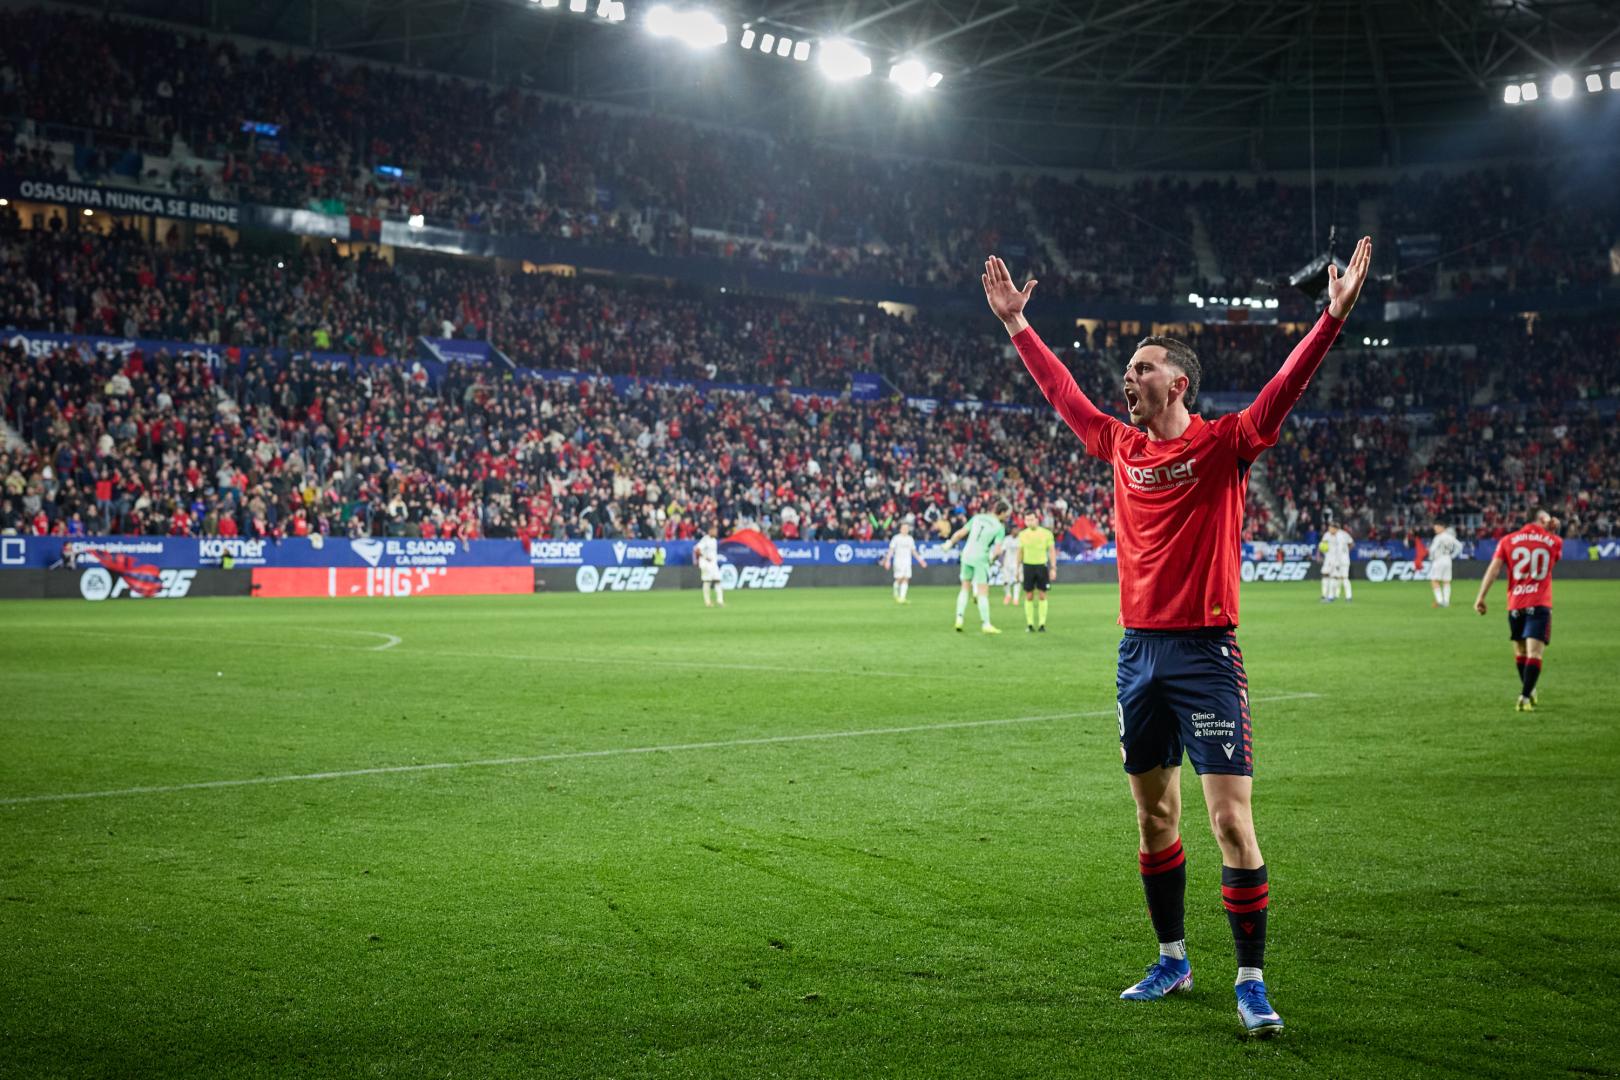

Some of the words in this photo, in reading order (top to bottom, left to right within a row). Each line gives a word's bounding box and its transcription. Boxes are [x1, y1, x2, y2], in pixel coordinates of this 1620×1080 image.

[20, 181, 101, 204] OSASUNA
[105, 191, 164, 213] NUNCA
[167, 200, 189, 216] SE
[190, 202, 239, 222] RINDE
[386, 540, 405, 555] EL
[406, 540, 456, 555] SADAR
[1254, 561, 1311, 581] FC26
[1386, 561, 1434, 581] FC2
[1511, 546, 1550, 580] 20
[597, 566, 659, 592] FC26
[736, 565, 793, 589] FC26
[1191, 720, 1235, 729] Universidad
[1194, 729, 1202, 737] de
[1203, 729, 1234, 737] Navarra
